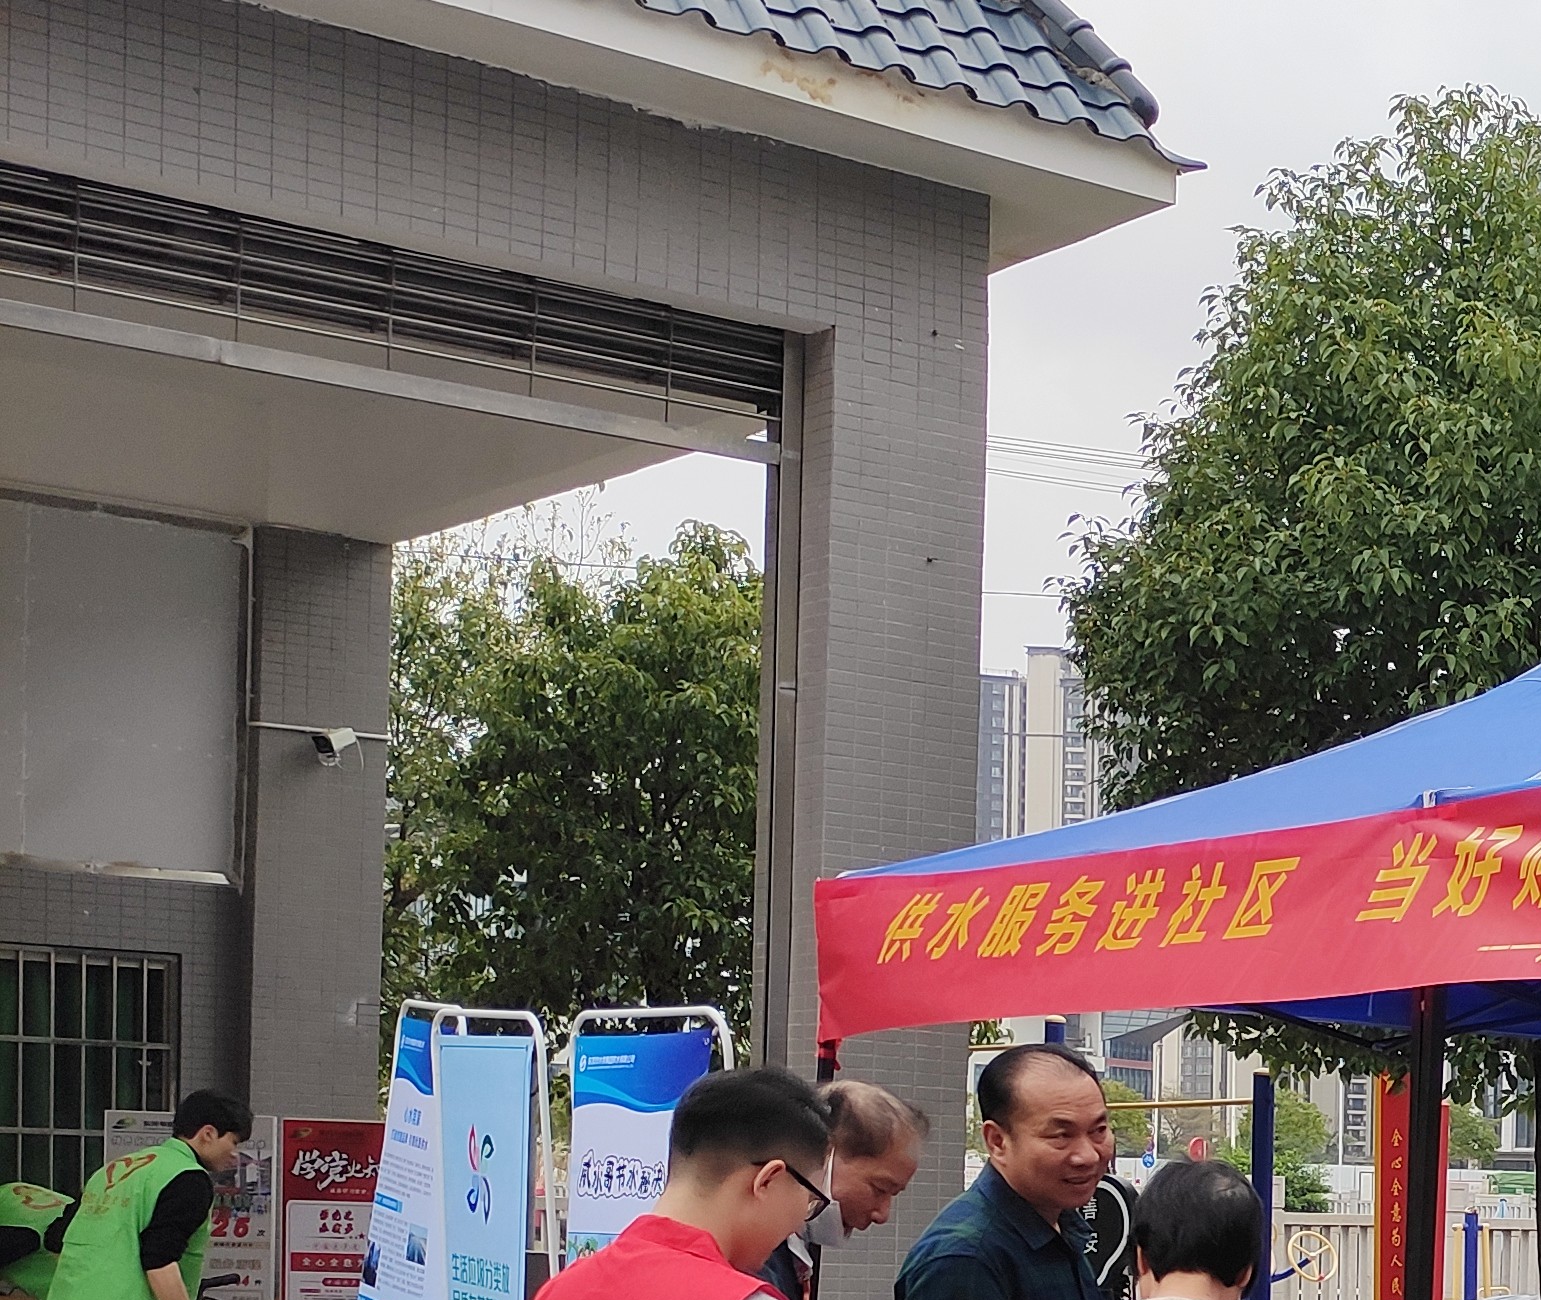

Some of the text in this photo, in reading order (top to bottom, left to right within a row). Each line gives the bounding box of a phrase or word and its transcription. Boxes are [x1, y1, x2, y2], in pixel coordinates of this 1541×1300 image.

[876, 855, 1301, 965] 供水服务进社区
